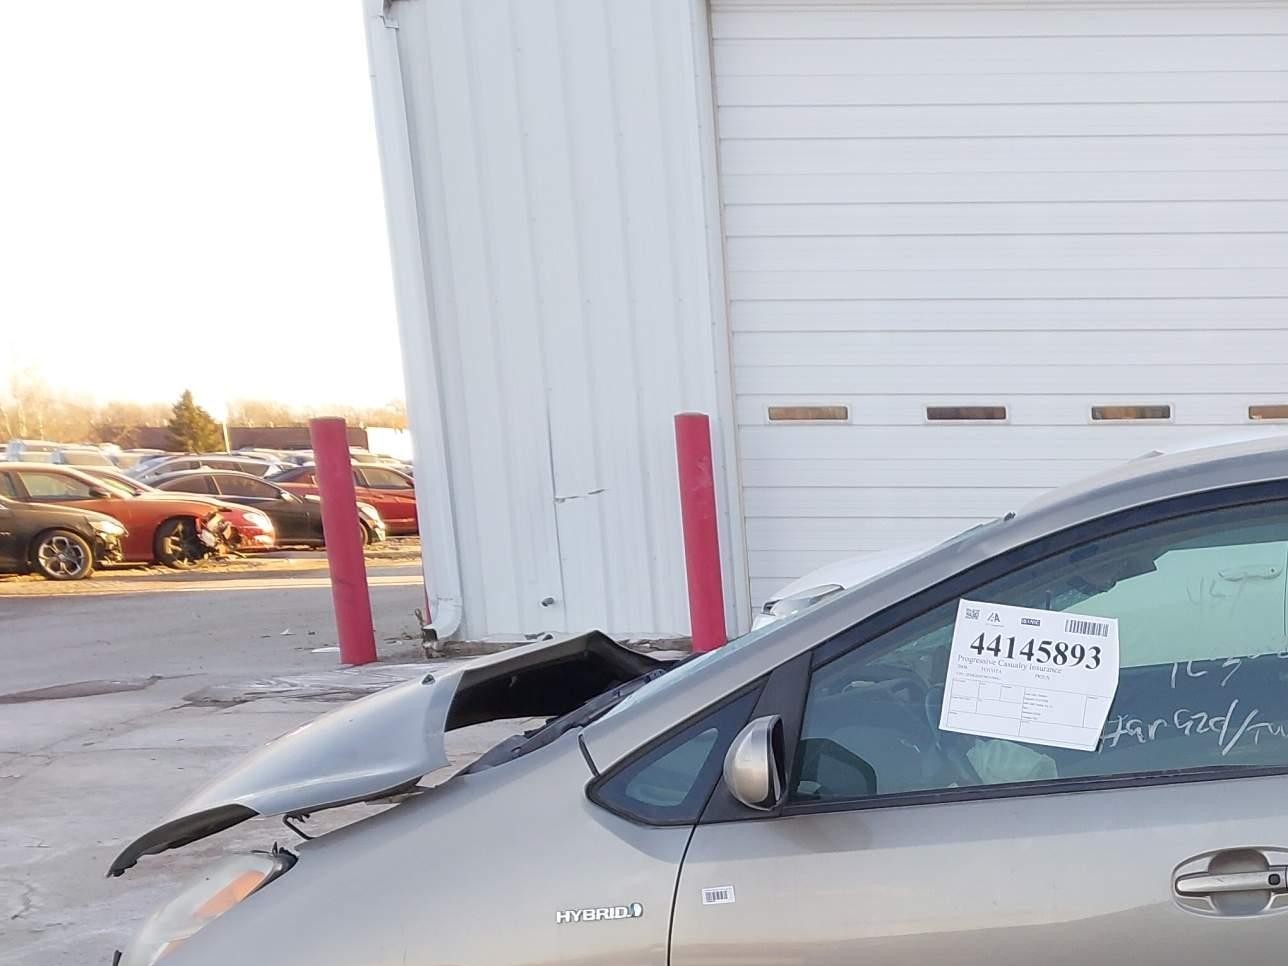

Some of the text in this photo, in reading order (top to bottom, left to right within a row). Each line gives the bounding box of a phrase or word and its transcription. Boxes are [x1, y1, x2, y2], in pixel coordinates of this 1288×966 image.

[970, 632, 1102, 670] 44145893
[957, 654, 997, 667] Progressive
[998, 659, 1027, 671] Casualty
[1029, 664, 1063, 674] Insurance
[556, 905, 630, 924] HYBRID
